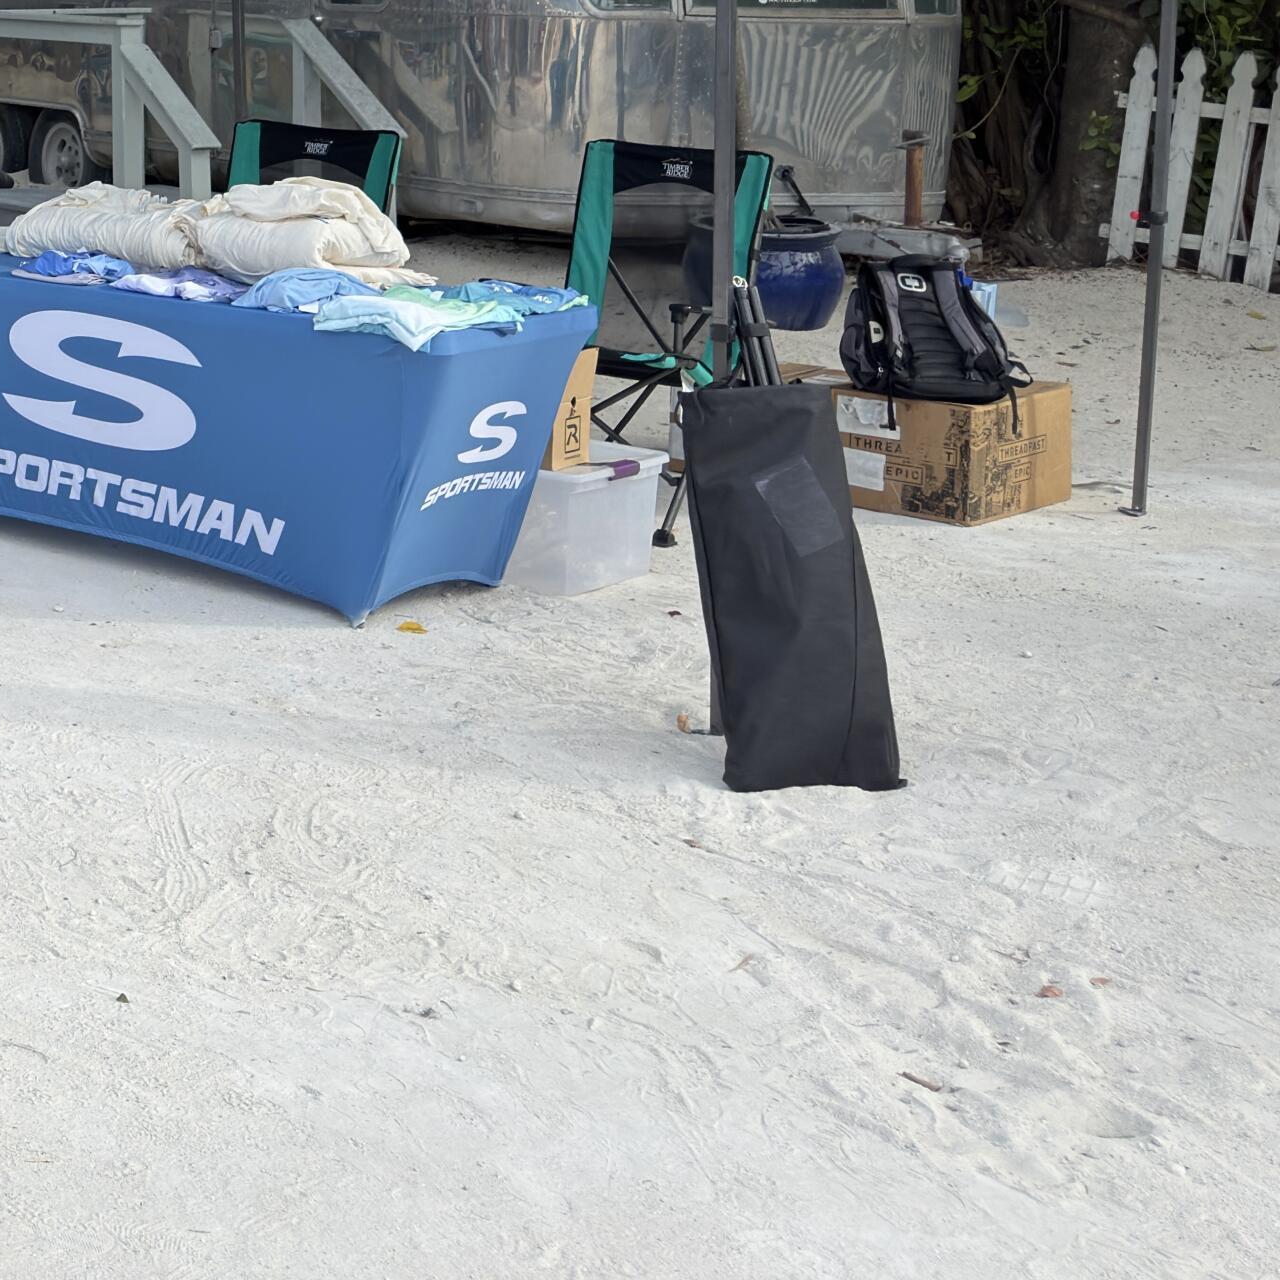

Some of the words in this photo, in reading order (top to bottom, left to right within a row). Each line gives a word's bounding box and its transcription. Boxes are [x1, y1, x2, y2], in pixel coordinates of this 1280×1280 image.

[662, 162, 690, 172] TIMBER
[1000, 439, 1045, 461] THREADFAST
[886, 466, 920, 480] EPIC
[1014, 466, 1030, 479] EPIC
[420, 471, 526, 511] SPORTSMAN
